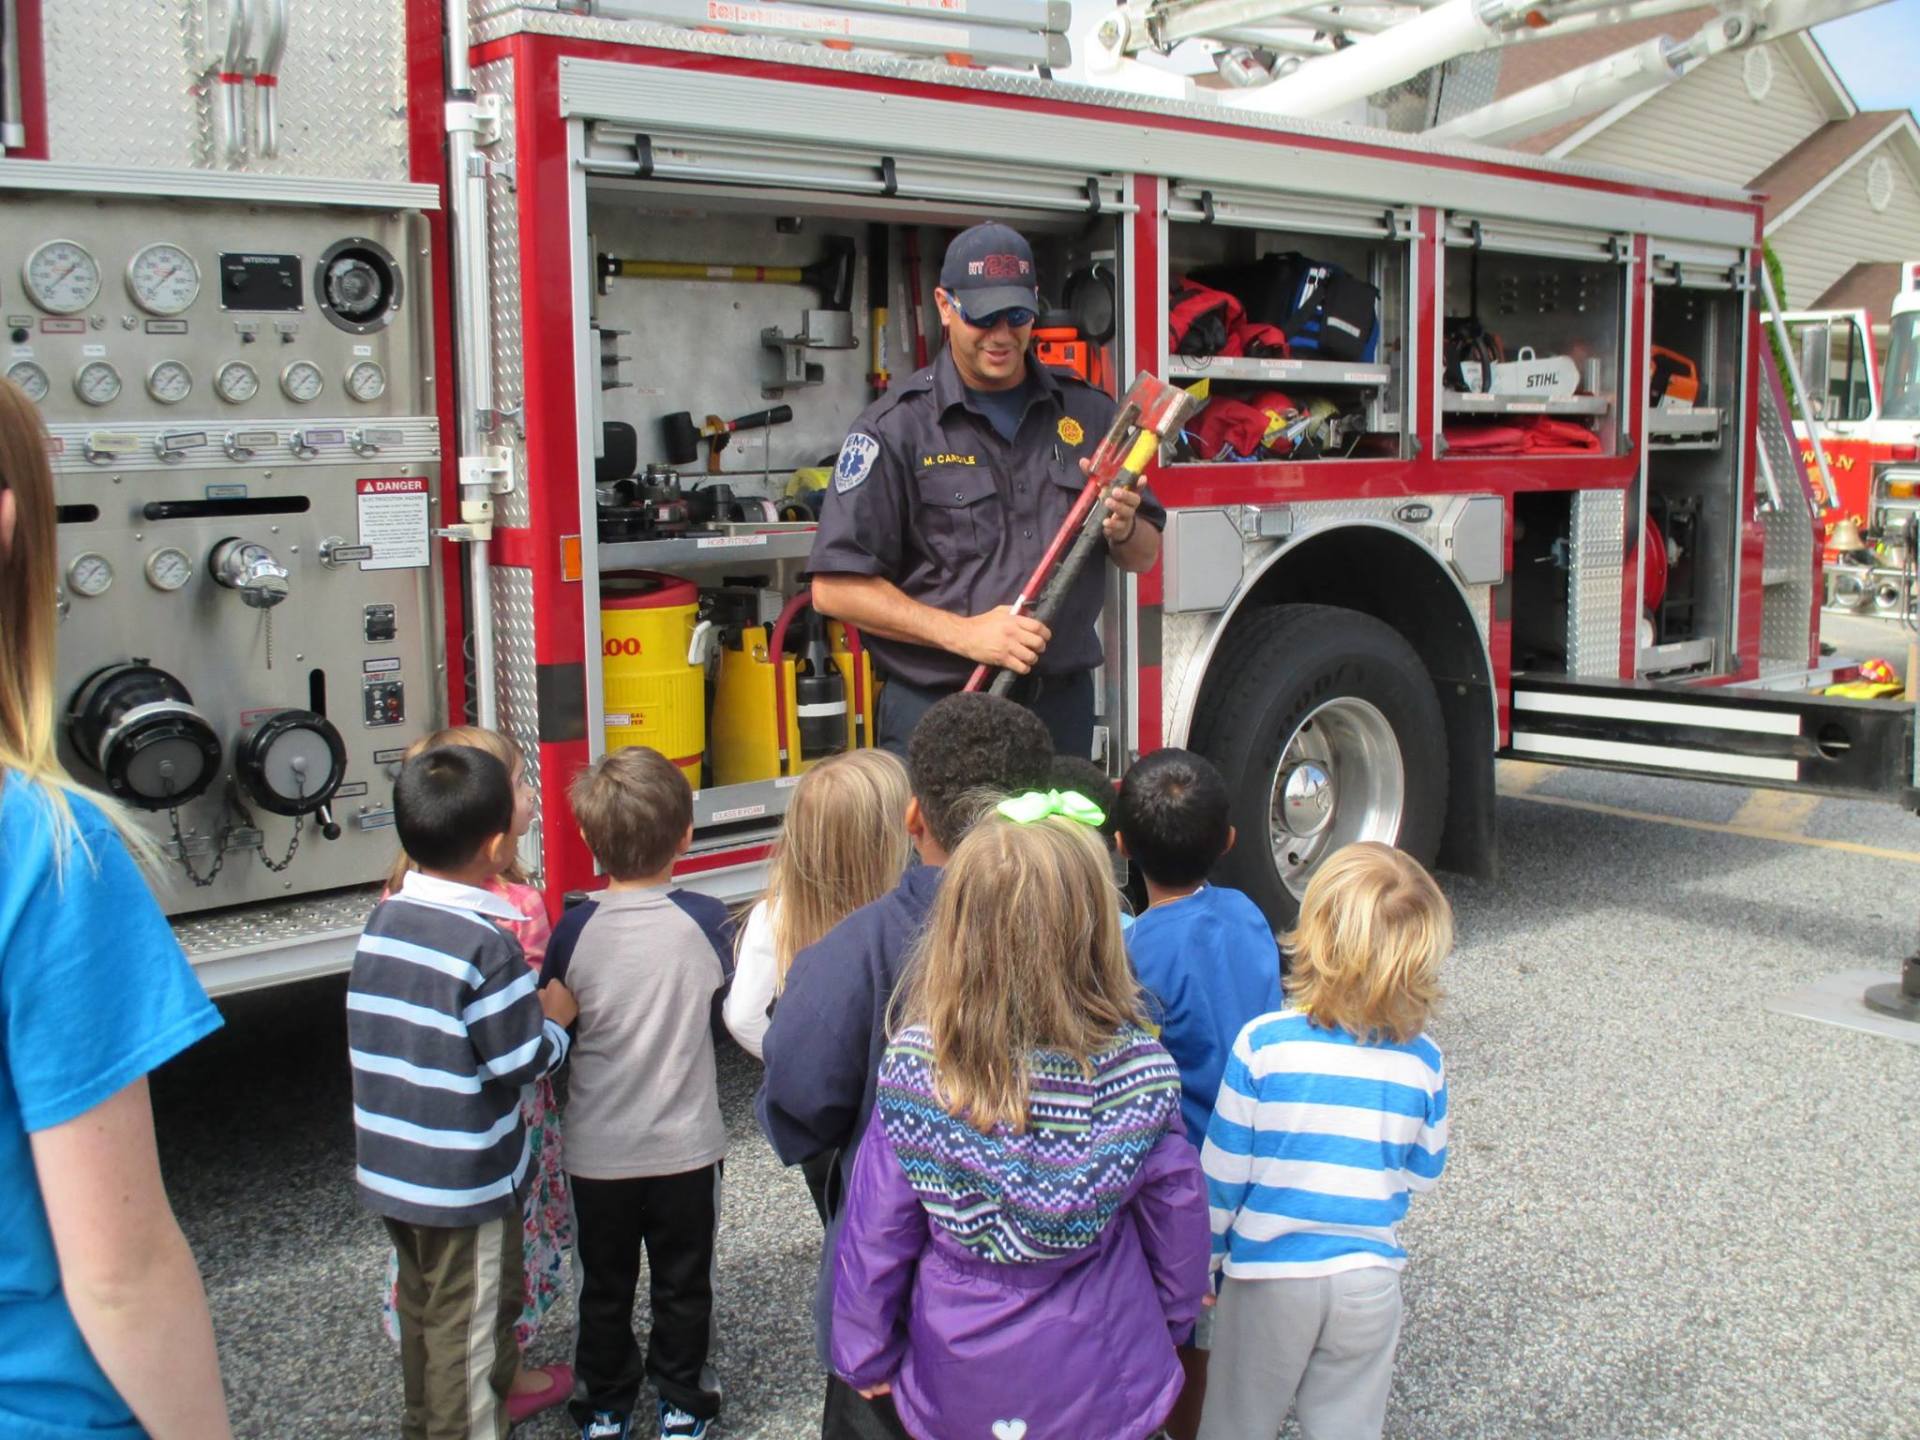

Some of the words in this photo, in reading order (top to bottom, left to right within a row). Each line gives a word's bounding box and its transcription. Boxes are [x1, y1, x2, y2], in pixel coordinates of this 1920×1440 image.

[1526, 372, 1559, 388] STIHL
[847, 434, 875, 452] EMT
[923, 456, 936, 467] M.
[376, 480, 422, 492] DANGER
